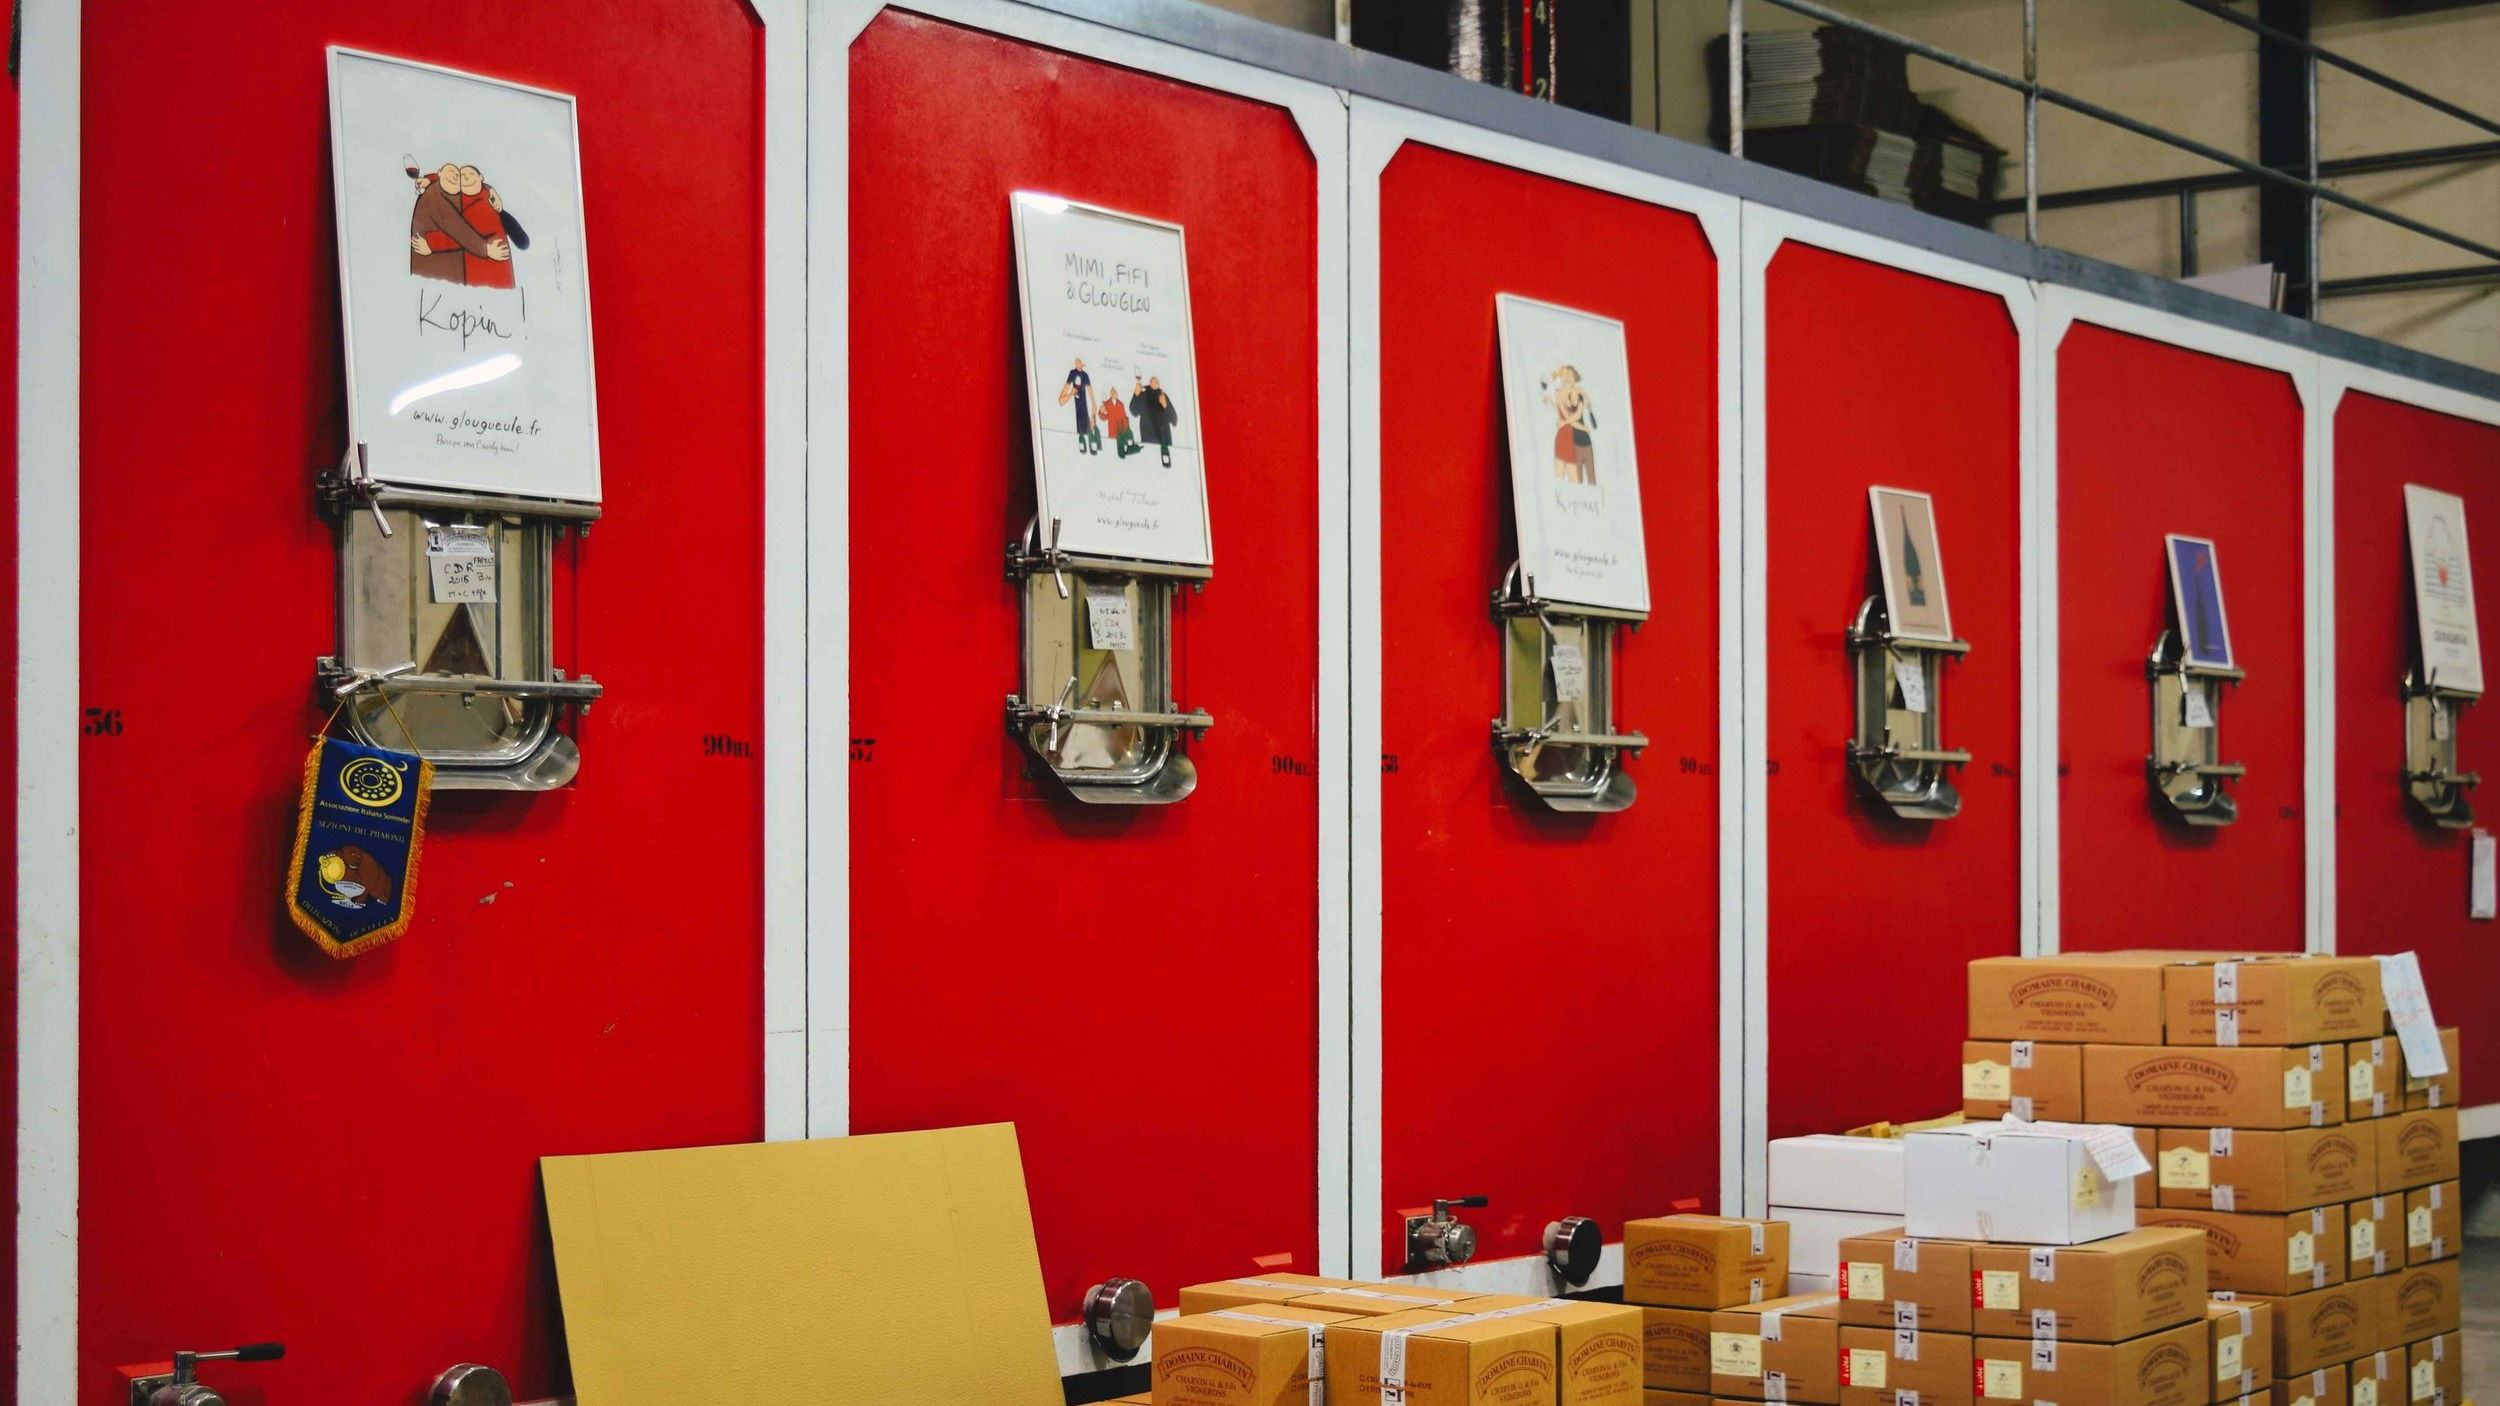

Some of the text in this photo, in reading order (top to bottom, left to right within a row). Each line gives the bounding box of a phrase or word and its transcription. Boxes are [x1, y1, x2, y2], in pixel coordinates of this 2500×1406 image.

[1536, 0, 1546, 24] 4
[1065, 253, 1148, 289] MIMI, FIFI
[1079, 281, 1150, 313] GLOUGLOU
[413, 410, 541, 435] www.glougueule.fr
[319, 800, 360, 814] Associazione
[2018, 979, 2108, 999] DOMAINE CHARVIN
[2134, 1061, 2228, 1081] DOMAINE CHARVIN
[2206, 1229, 2231, 1245] RVIN
[1572, 1338, 1635, 1366] DOMAINE CHARVIN
[1165, 1351, 1247, 1379] DOMAINE CHARVIN
[1482, 1355, 1547, 1385] DOMAINE CHARVIN
